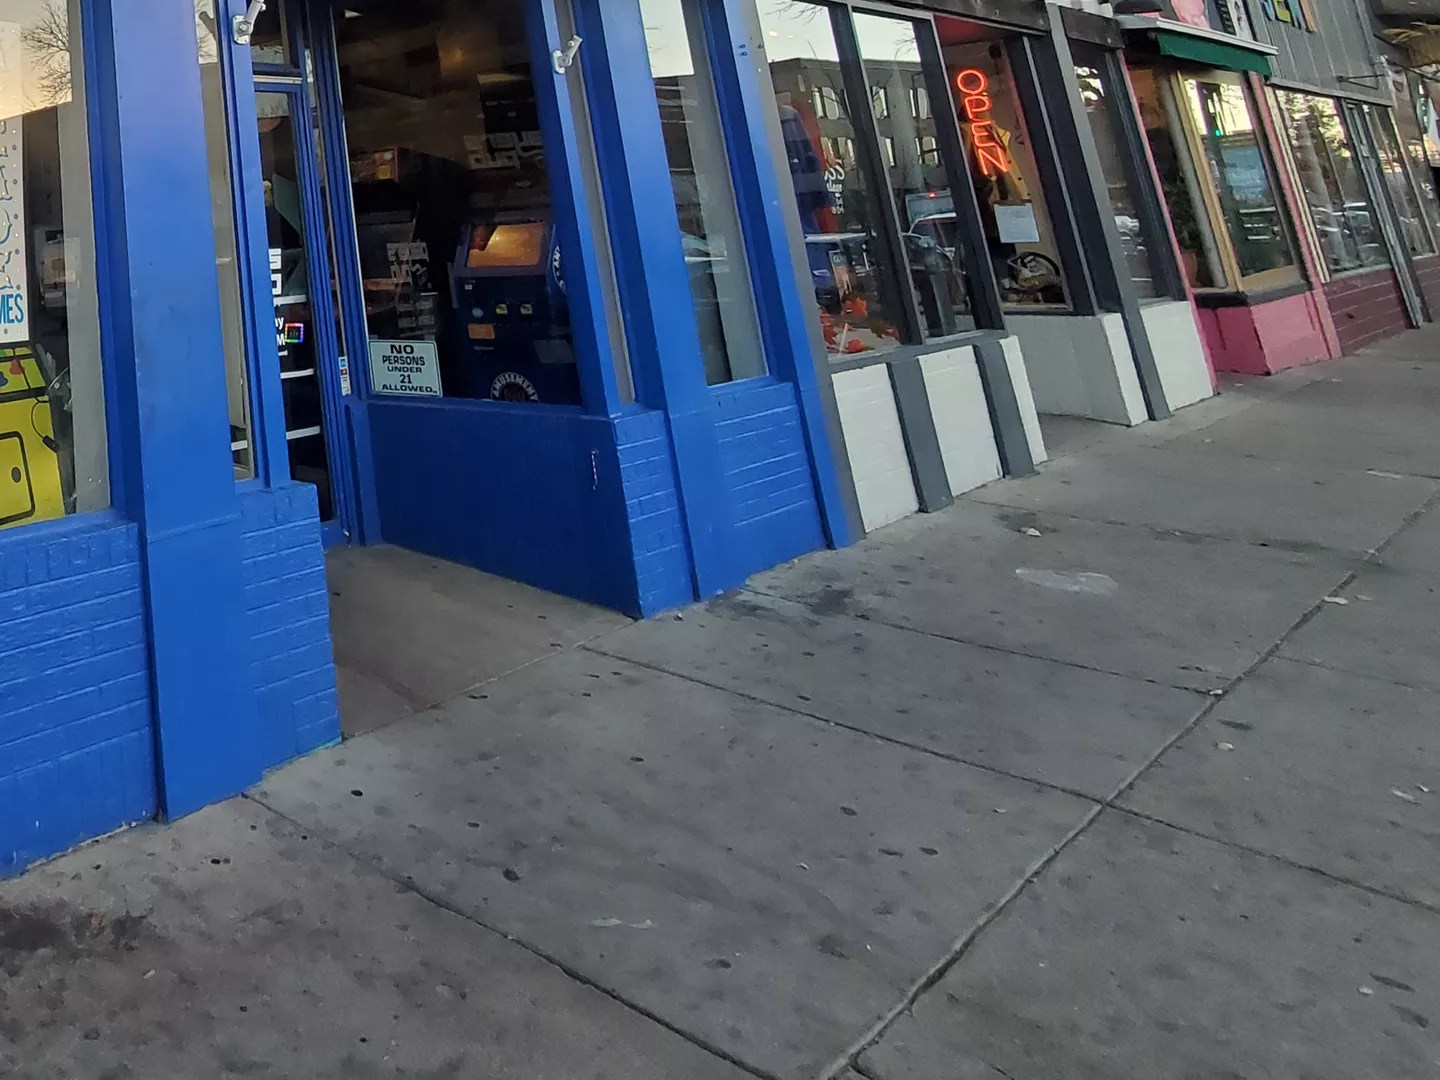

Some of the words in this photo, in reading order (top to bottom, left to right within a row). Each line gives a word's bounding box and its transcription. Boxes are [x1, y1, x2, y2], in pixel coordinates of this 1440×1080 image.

[956, 70, 1010, 176] OPEN
[390, 344, 415, 354] NO
[382, 355, 426, 366] PERSONS
[399, 374, 413, 384] 21
[381, 384, 433, 392] ALLOWED
